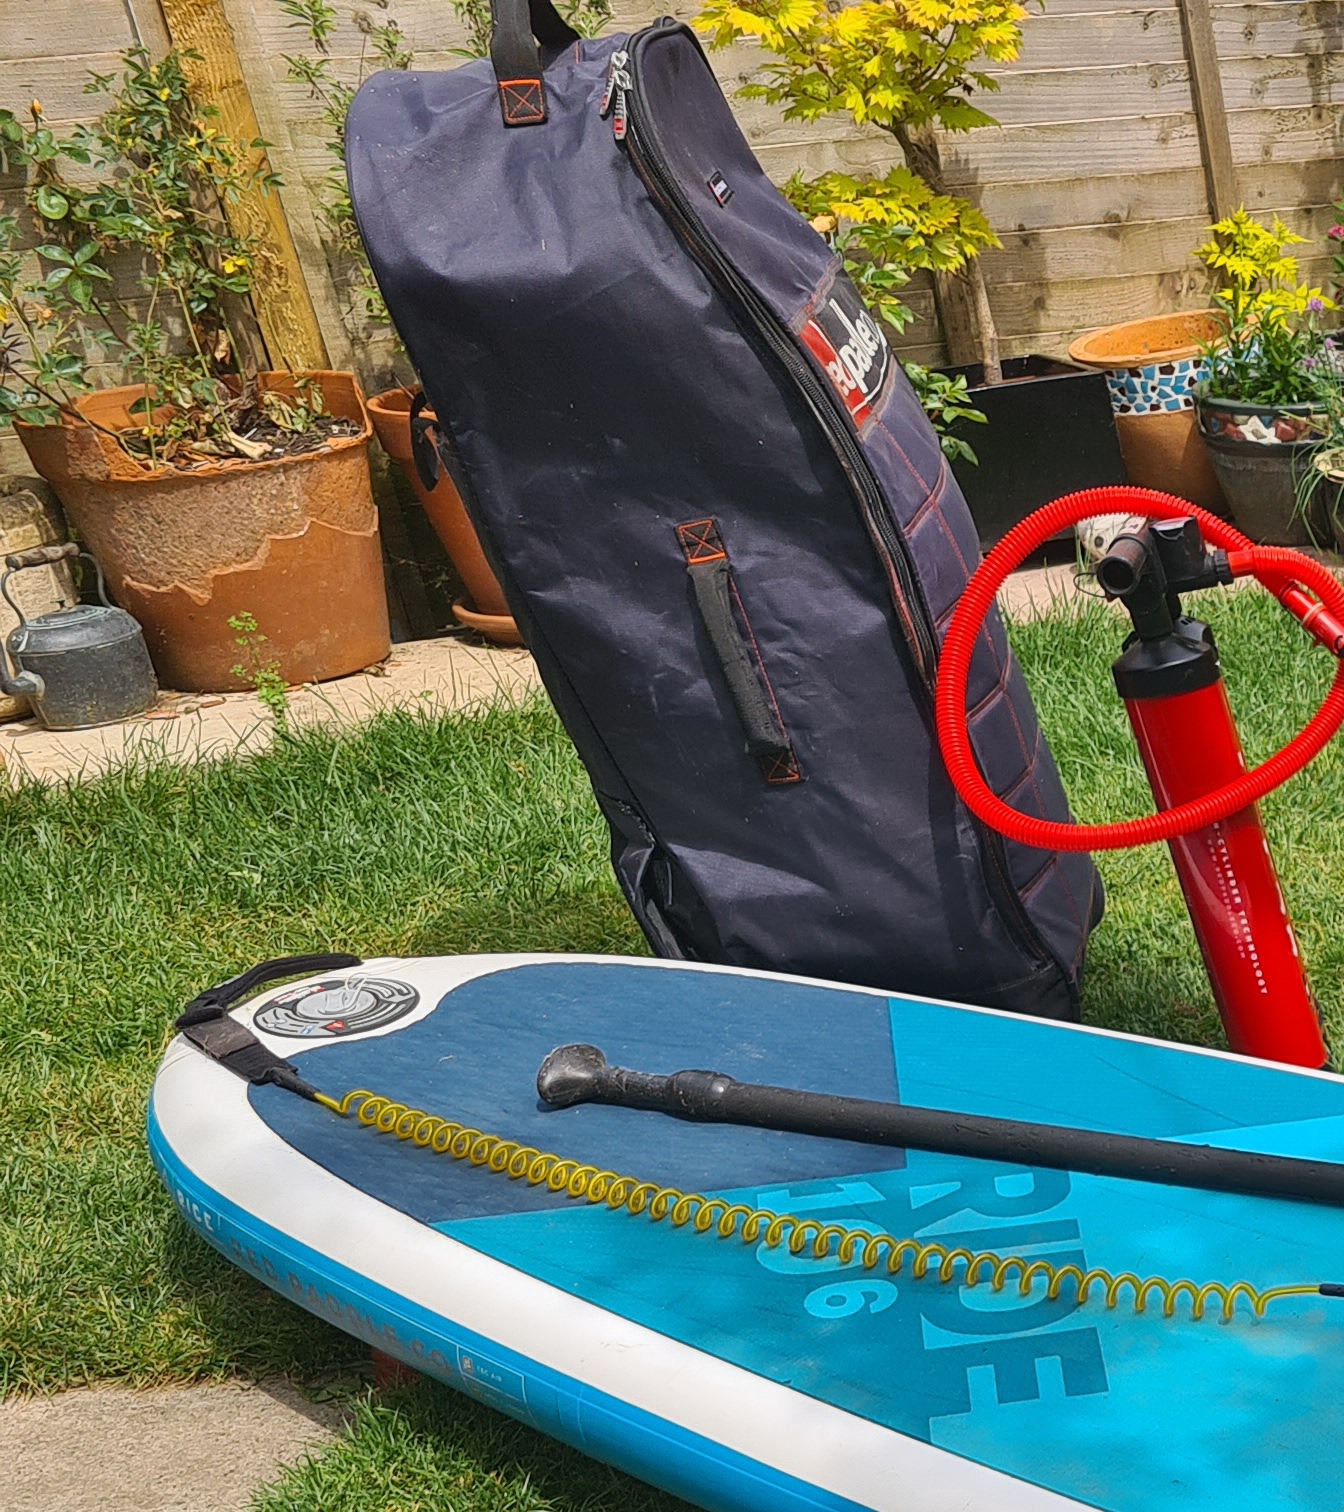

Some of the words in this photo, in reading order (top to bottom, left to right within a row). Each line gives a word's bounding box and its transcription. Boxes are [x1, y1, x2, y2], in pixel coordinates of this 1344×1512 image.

[1213, 822, 1242, 904] N-CYLINDER
[1238, 910, 1268, 994] TECHNOLOGY
[906, 1160, 1109, 1418] RIDE
